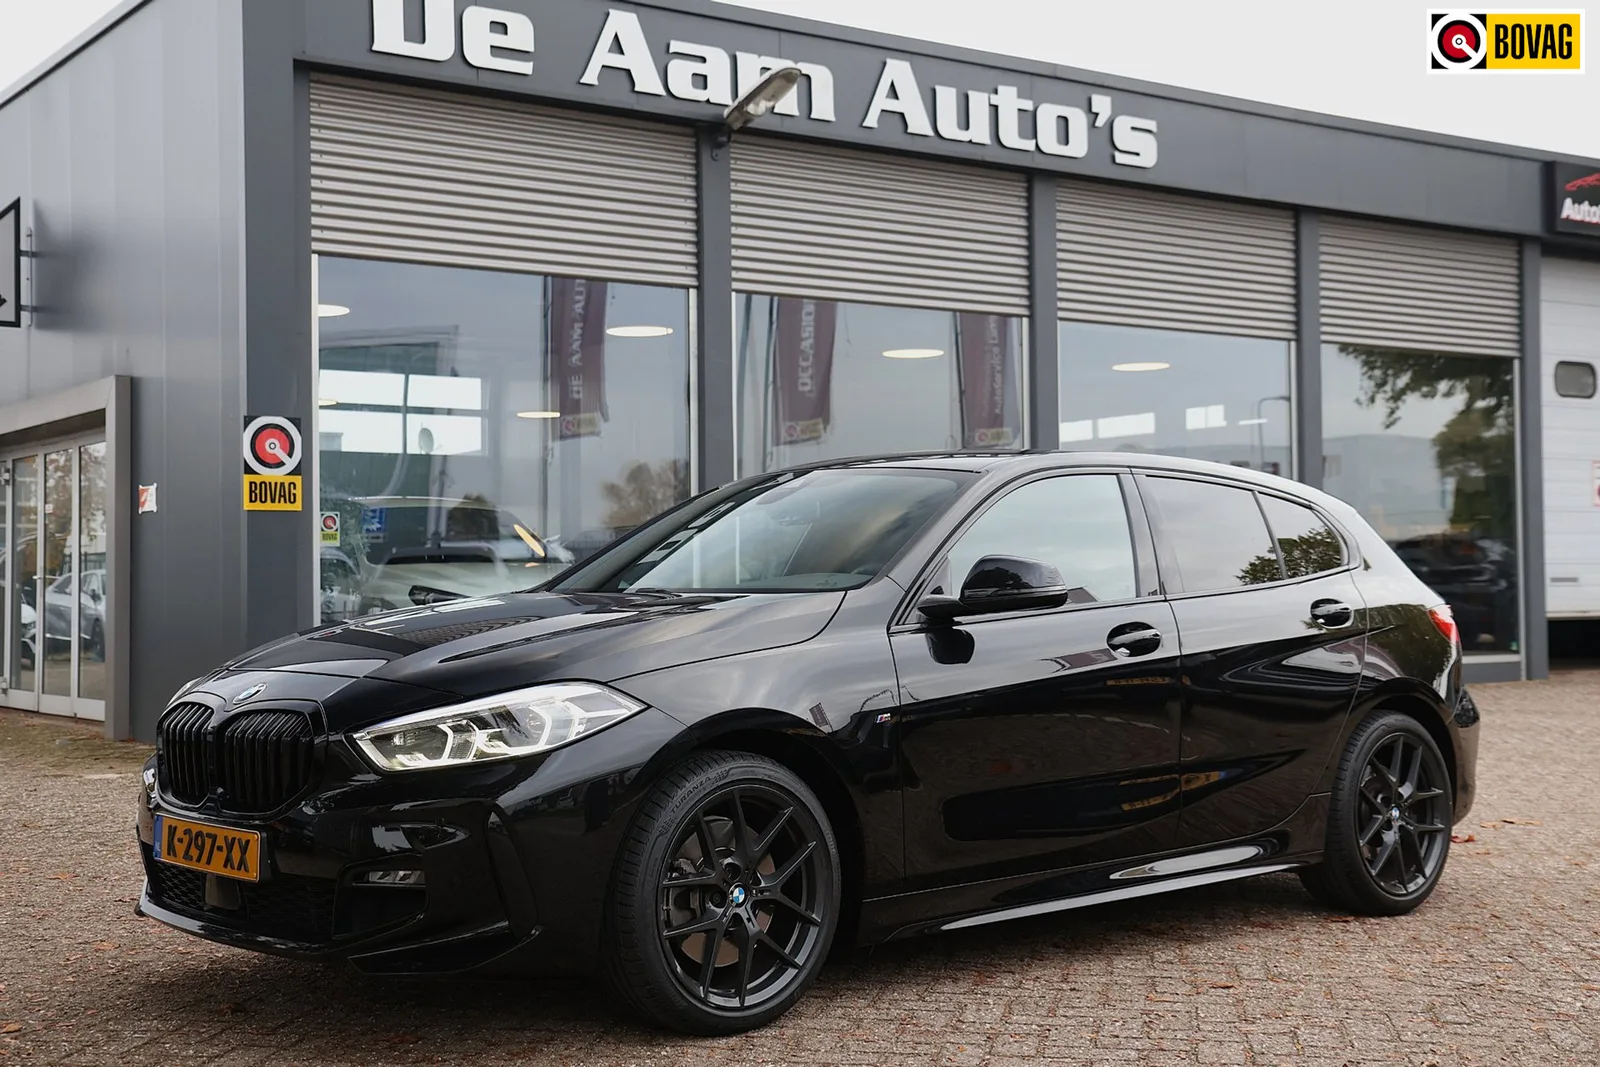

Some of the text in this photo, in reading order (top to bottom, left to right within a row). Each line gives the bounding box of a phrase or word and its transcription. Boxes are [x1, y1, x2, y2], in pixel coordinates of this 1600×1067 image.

[371, 0, 1158, 168] De Aam Auto's
[1560, 197, 1600, 224] Auto
[249, 480, 297, 504] BOVAG
[322, 533, 338, 541] BOVAG
[669, 776, 711, 814] TURANZA
[167, 824, 250, 873] K-297-XX
